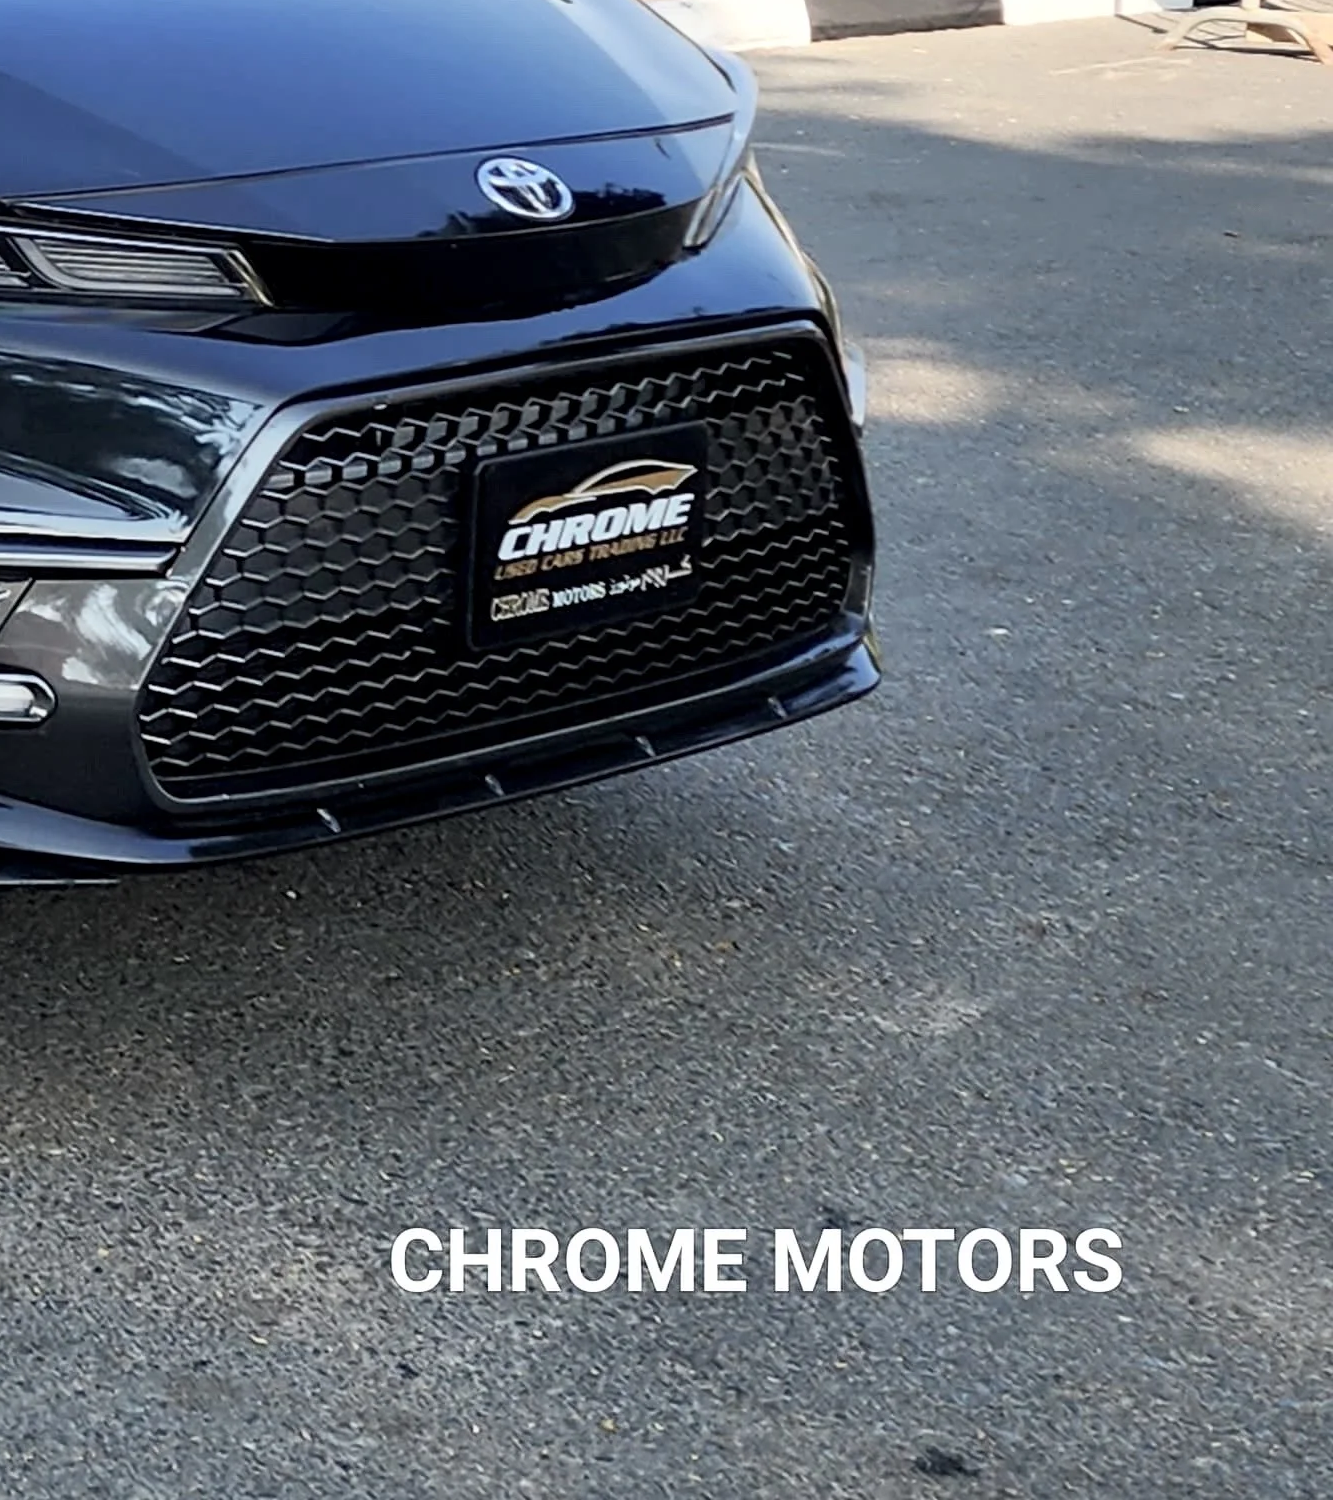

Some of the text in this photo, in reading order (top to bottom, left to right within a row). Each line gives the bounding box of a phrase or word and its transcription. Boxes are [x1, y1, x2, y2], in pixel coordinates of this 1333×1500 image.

[497, 493, 695, 561] CHROME
[540, 549, 586, 571] CARS
[588, 532, 659, 562] TRADING
[551, 581, 607, 608] MOTORS
